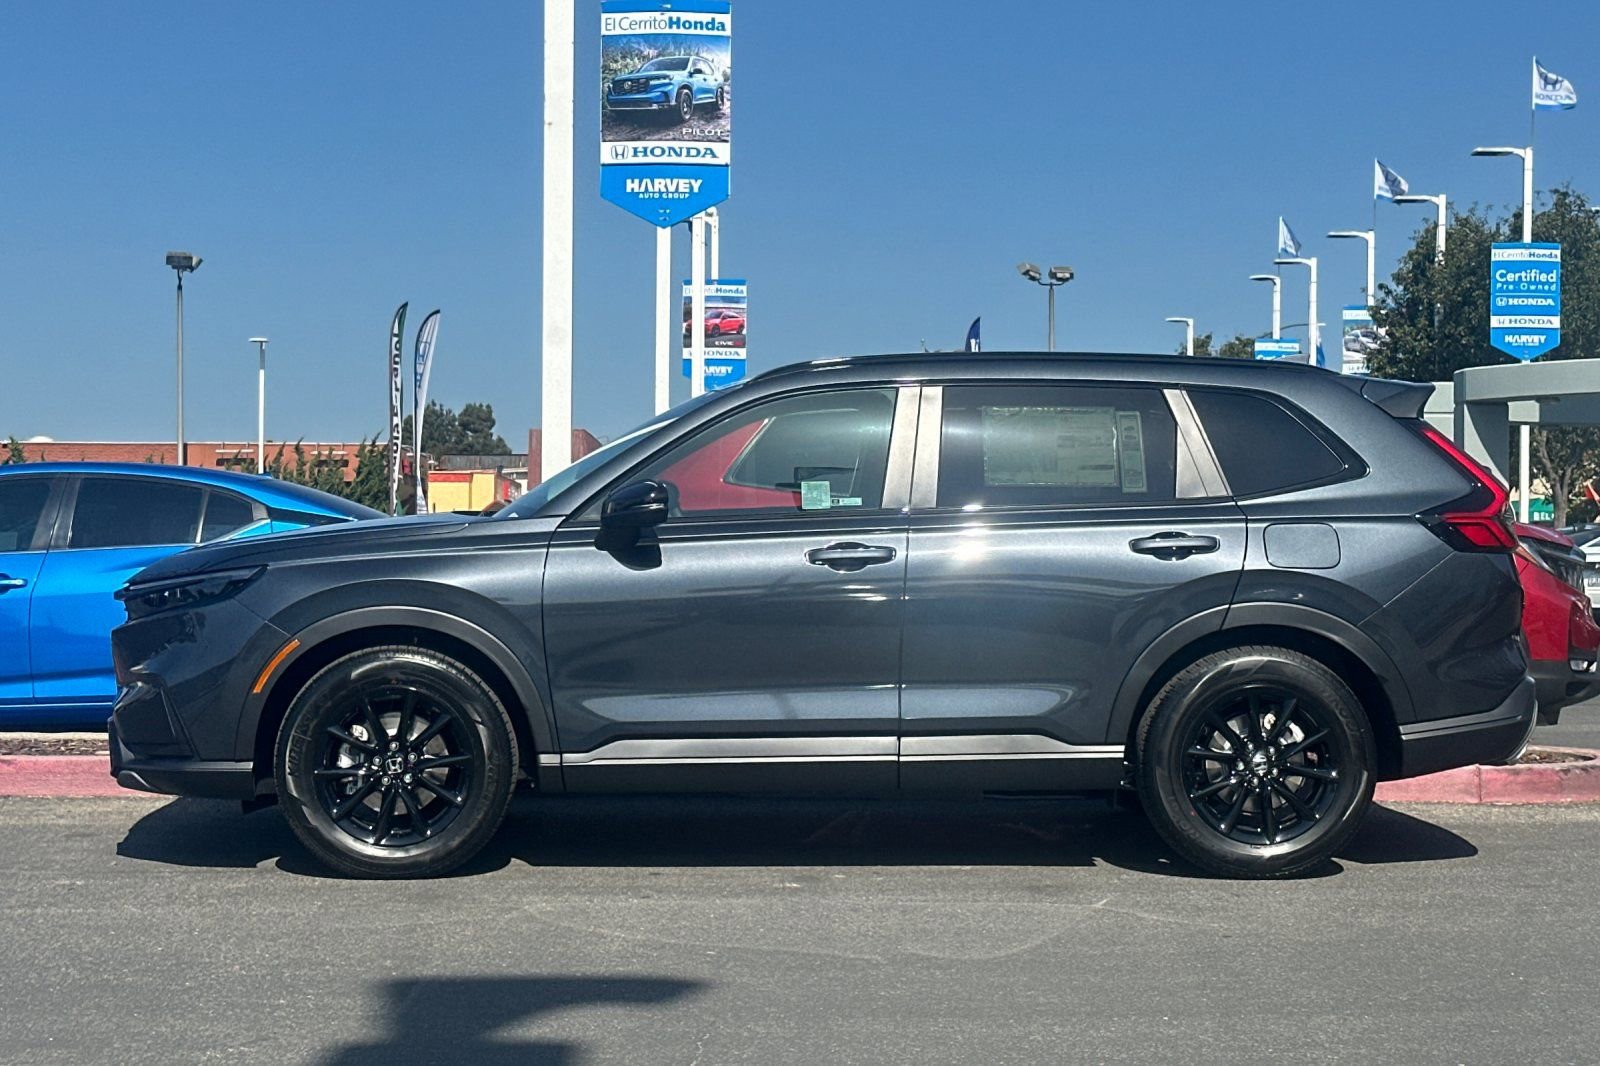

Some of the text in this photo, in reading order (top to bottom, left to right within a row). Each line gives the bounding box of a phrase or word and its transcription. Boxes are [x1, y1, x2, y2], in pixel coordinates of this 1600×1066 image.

[604, 17, 616, 31] El
[682, 127, 723, 136] PILOT
[631, 146, 719, 159] HONDA
[625, 178, 703, 193] HARVEY
[1495, 269, 1556, 282] Certified
[1508, 298, 1555, 306] HONDA
[1504, 335, 1546, 343] HARVEY
[704, 366, 733, 374] ARVEY
